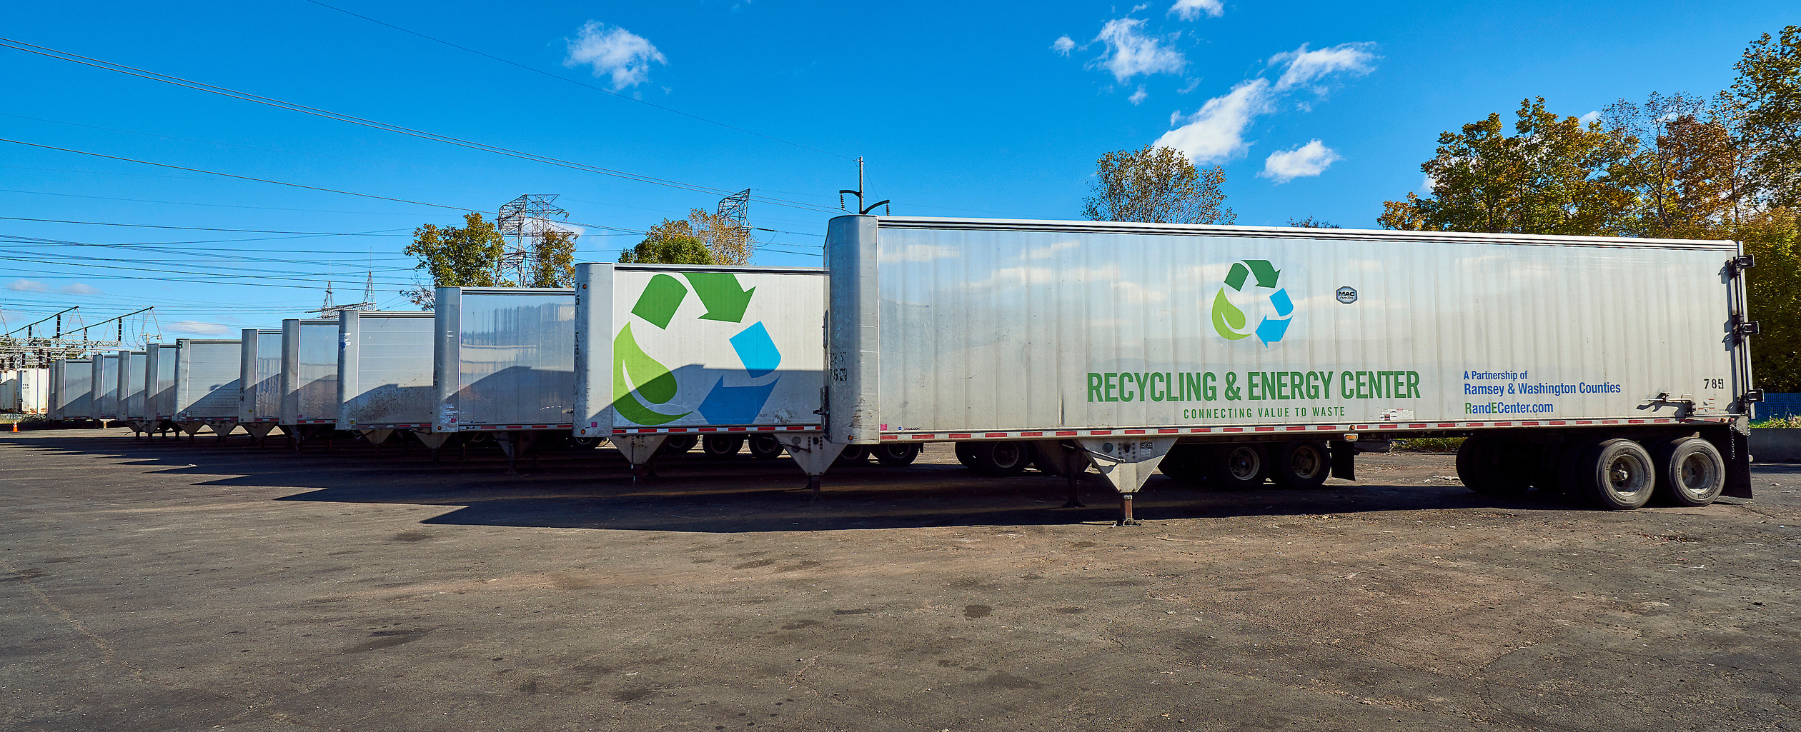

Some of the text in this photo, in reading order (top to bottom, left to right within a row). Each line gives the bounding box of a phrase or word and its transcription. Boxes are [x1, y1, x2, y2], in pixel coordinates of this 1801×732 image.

[1463, 370, 1528, 381] A Partnership of
[1087, 370, 1421, 402] RECYCLING & ENERGY CENTER
[1464, 381, 1621, 397] Ramsey & Washington Counties
[1183, 406, 1345, 419] CONNECTING VALUE TO WASTE
[1465, 402, 1554, 414] RandECenter.com
